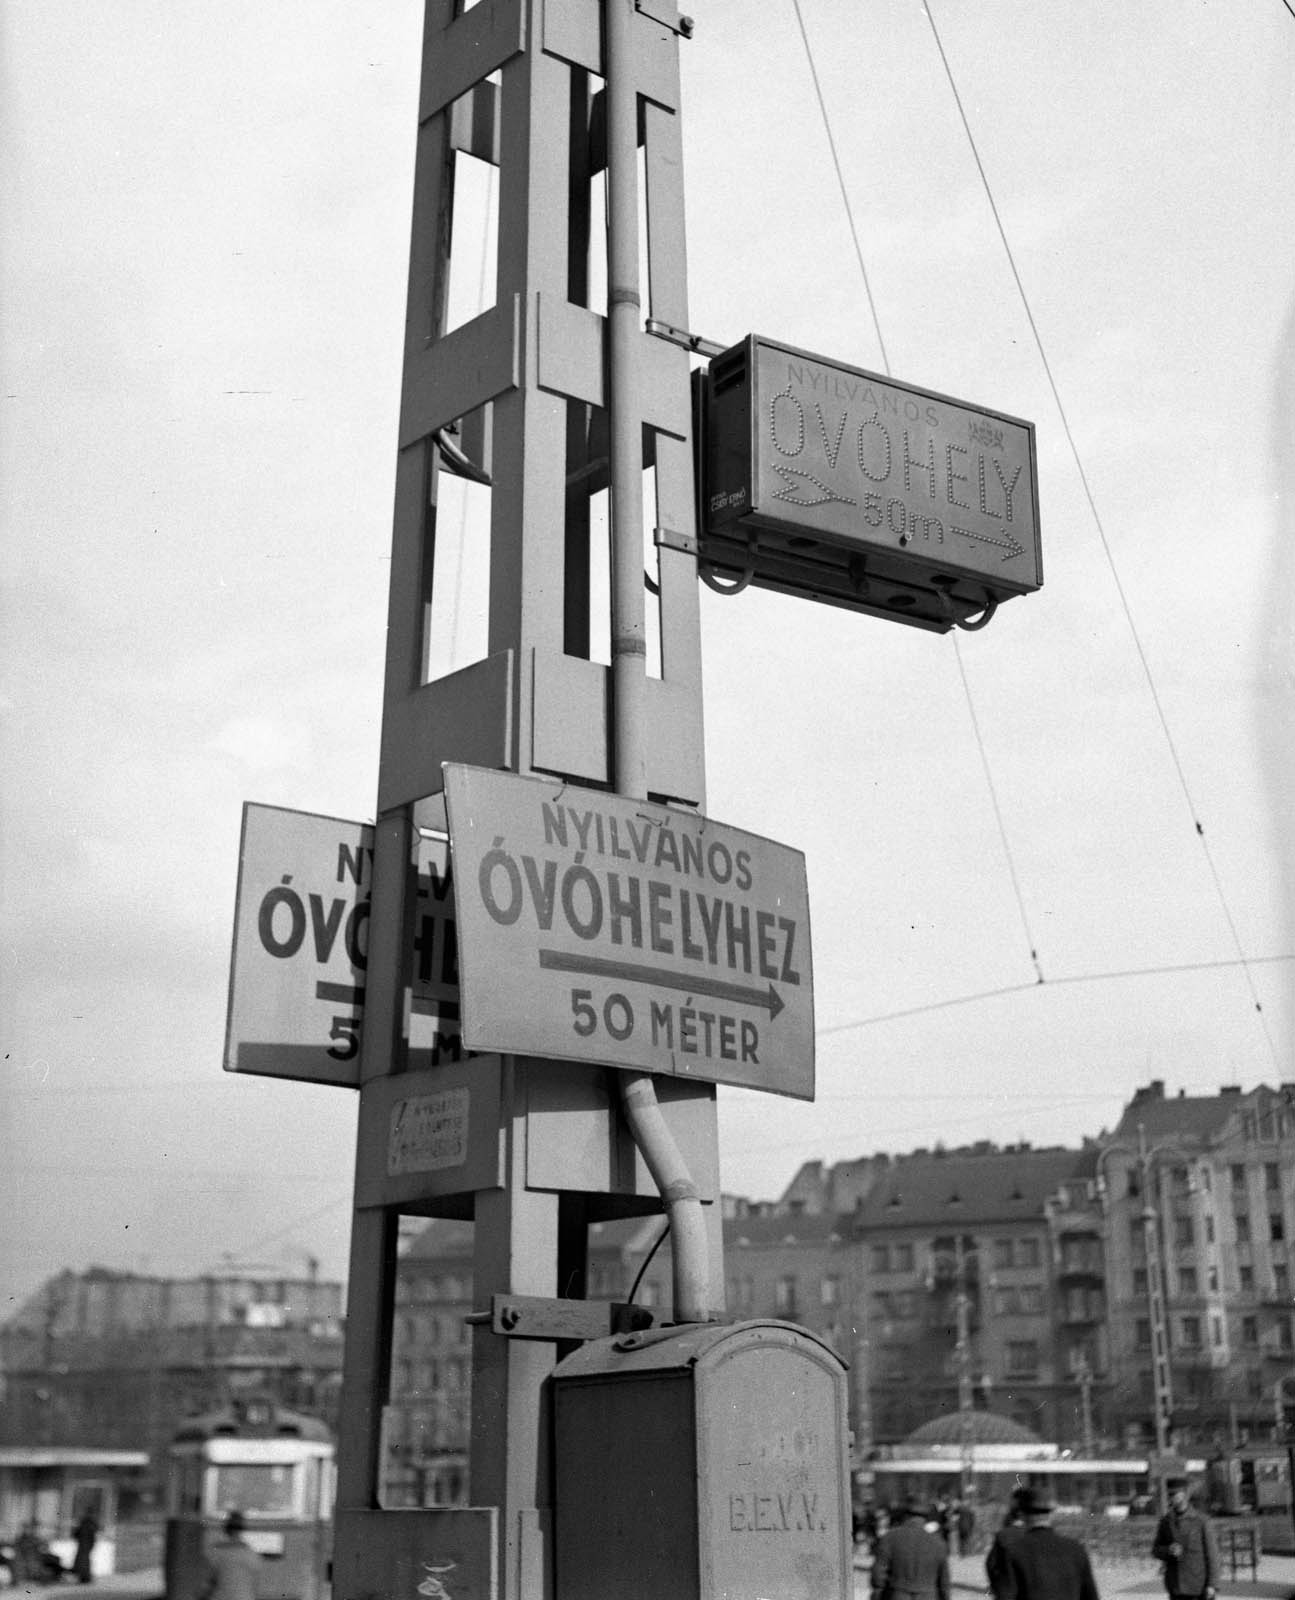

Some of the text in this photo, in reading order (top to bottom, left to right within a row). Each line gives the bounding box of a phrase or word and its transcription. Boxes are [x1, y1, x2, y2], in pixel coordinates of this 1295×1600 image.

[769, 383, 1023, 522] ÓVÓHELY
[864, 490, 943, 544] 50m
[542, 802, 752, 891] NYILVÁNOS
[478, 836, 800, 985] ÓVÓHELYHEZ
[571, 988, 760, 1064] 50 MÉTER
